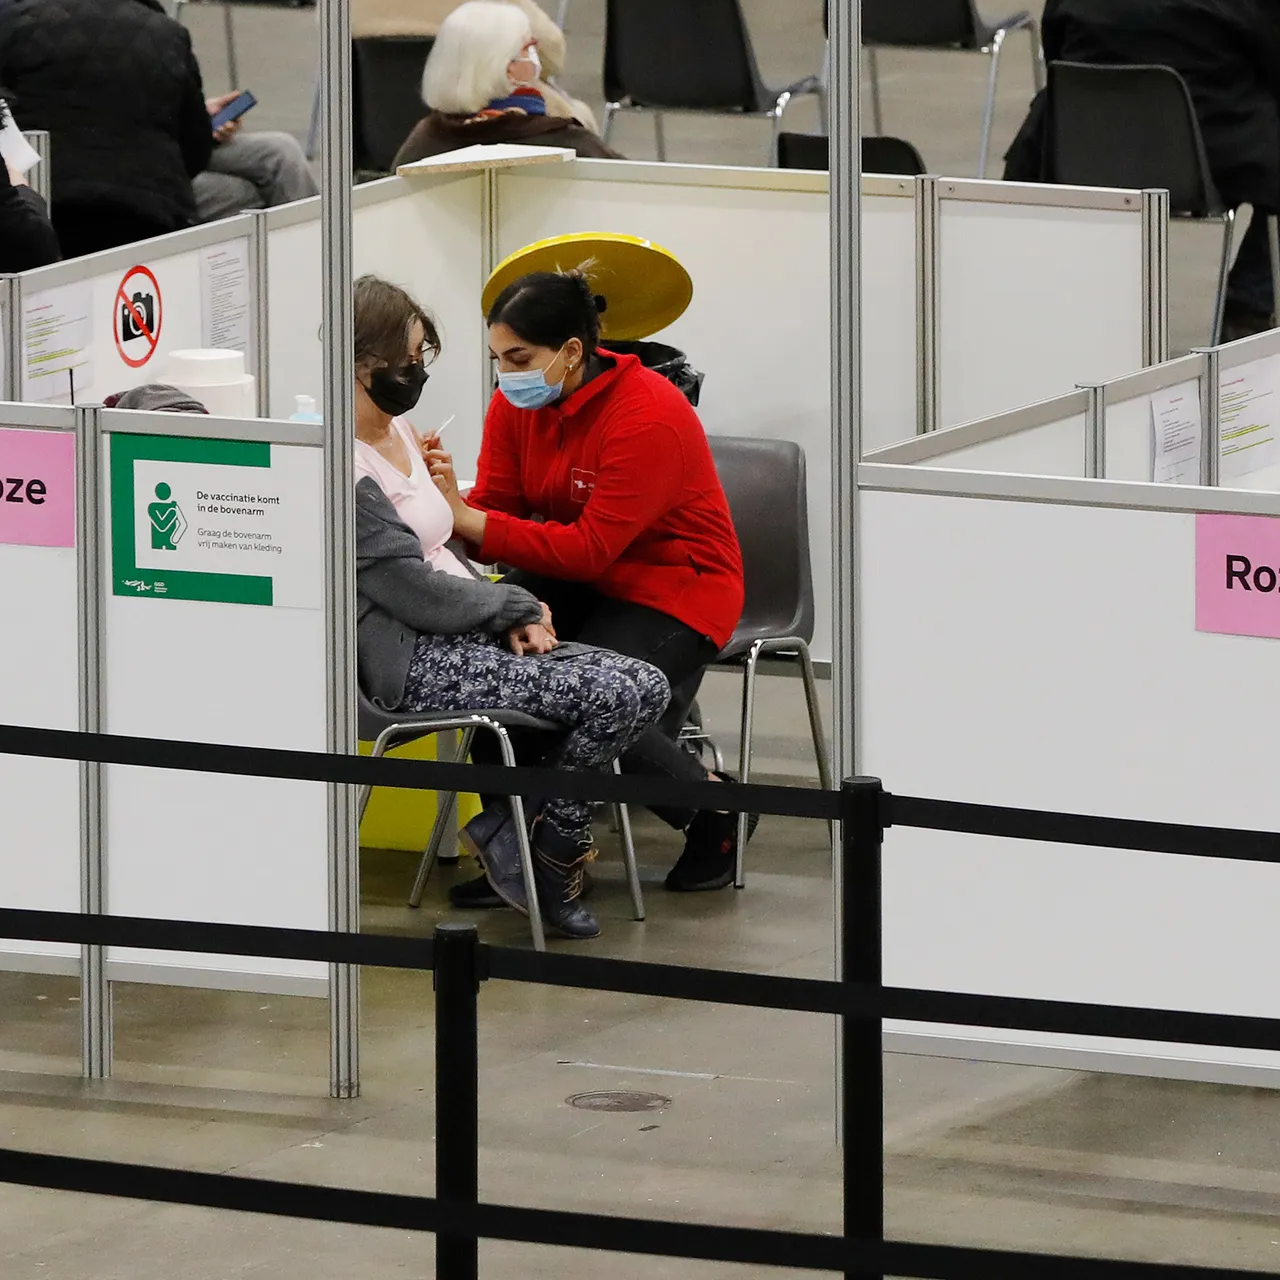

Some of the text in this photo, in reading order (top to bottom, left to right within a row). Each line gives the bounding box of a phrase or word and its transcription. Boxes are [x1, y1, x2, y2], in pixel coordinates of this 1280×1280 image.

[196, 491, 280, 504] De vaccinatie komt
[197, 503, 265, 516] in de bovenarm
[197, 527, 272, 540] Graag de bovenarm
[198, 540, 282, 554] vrij maken van kleding
